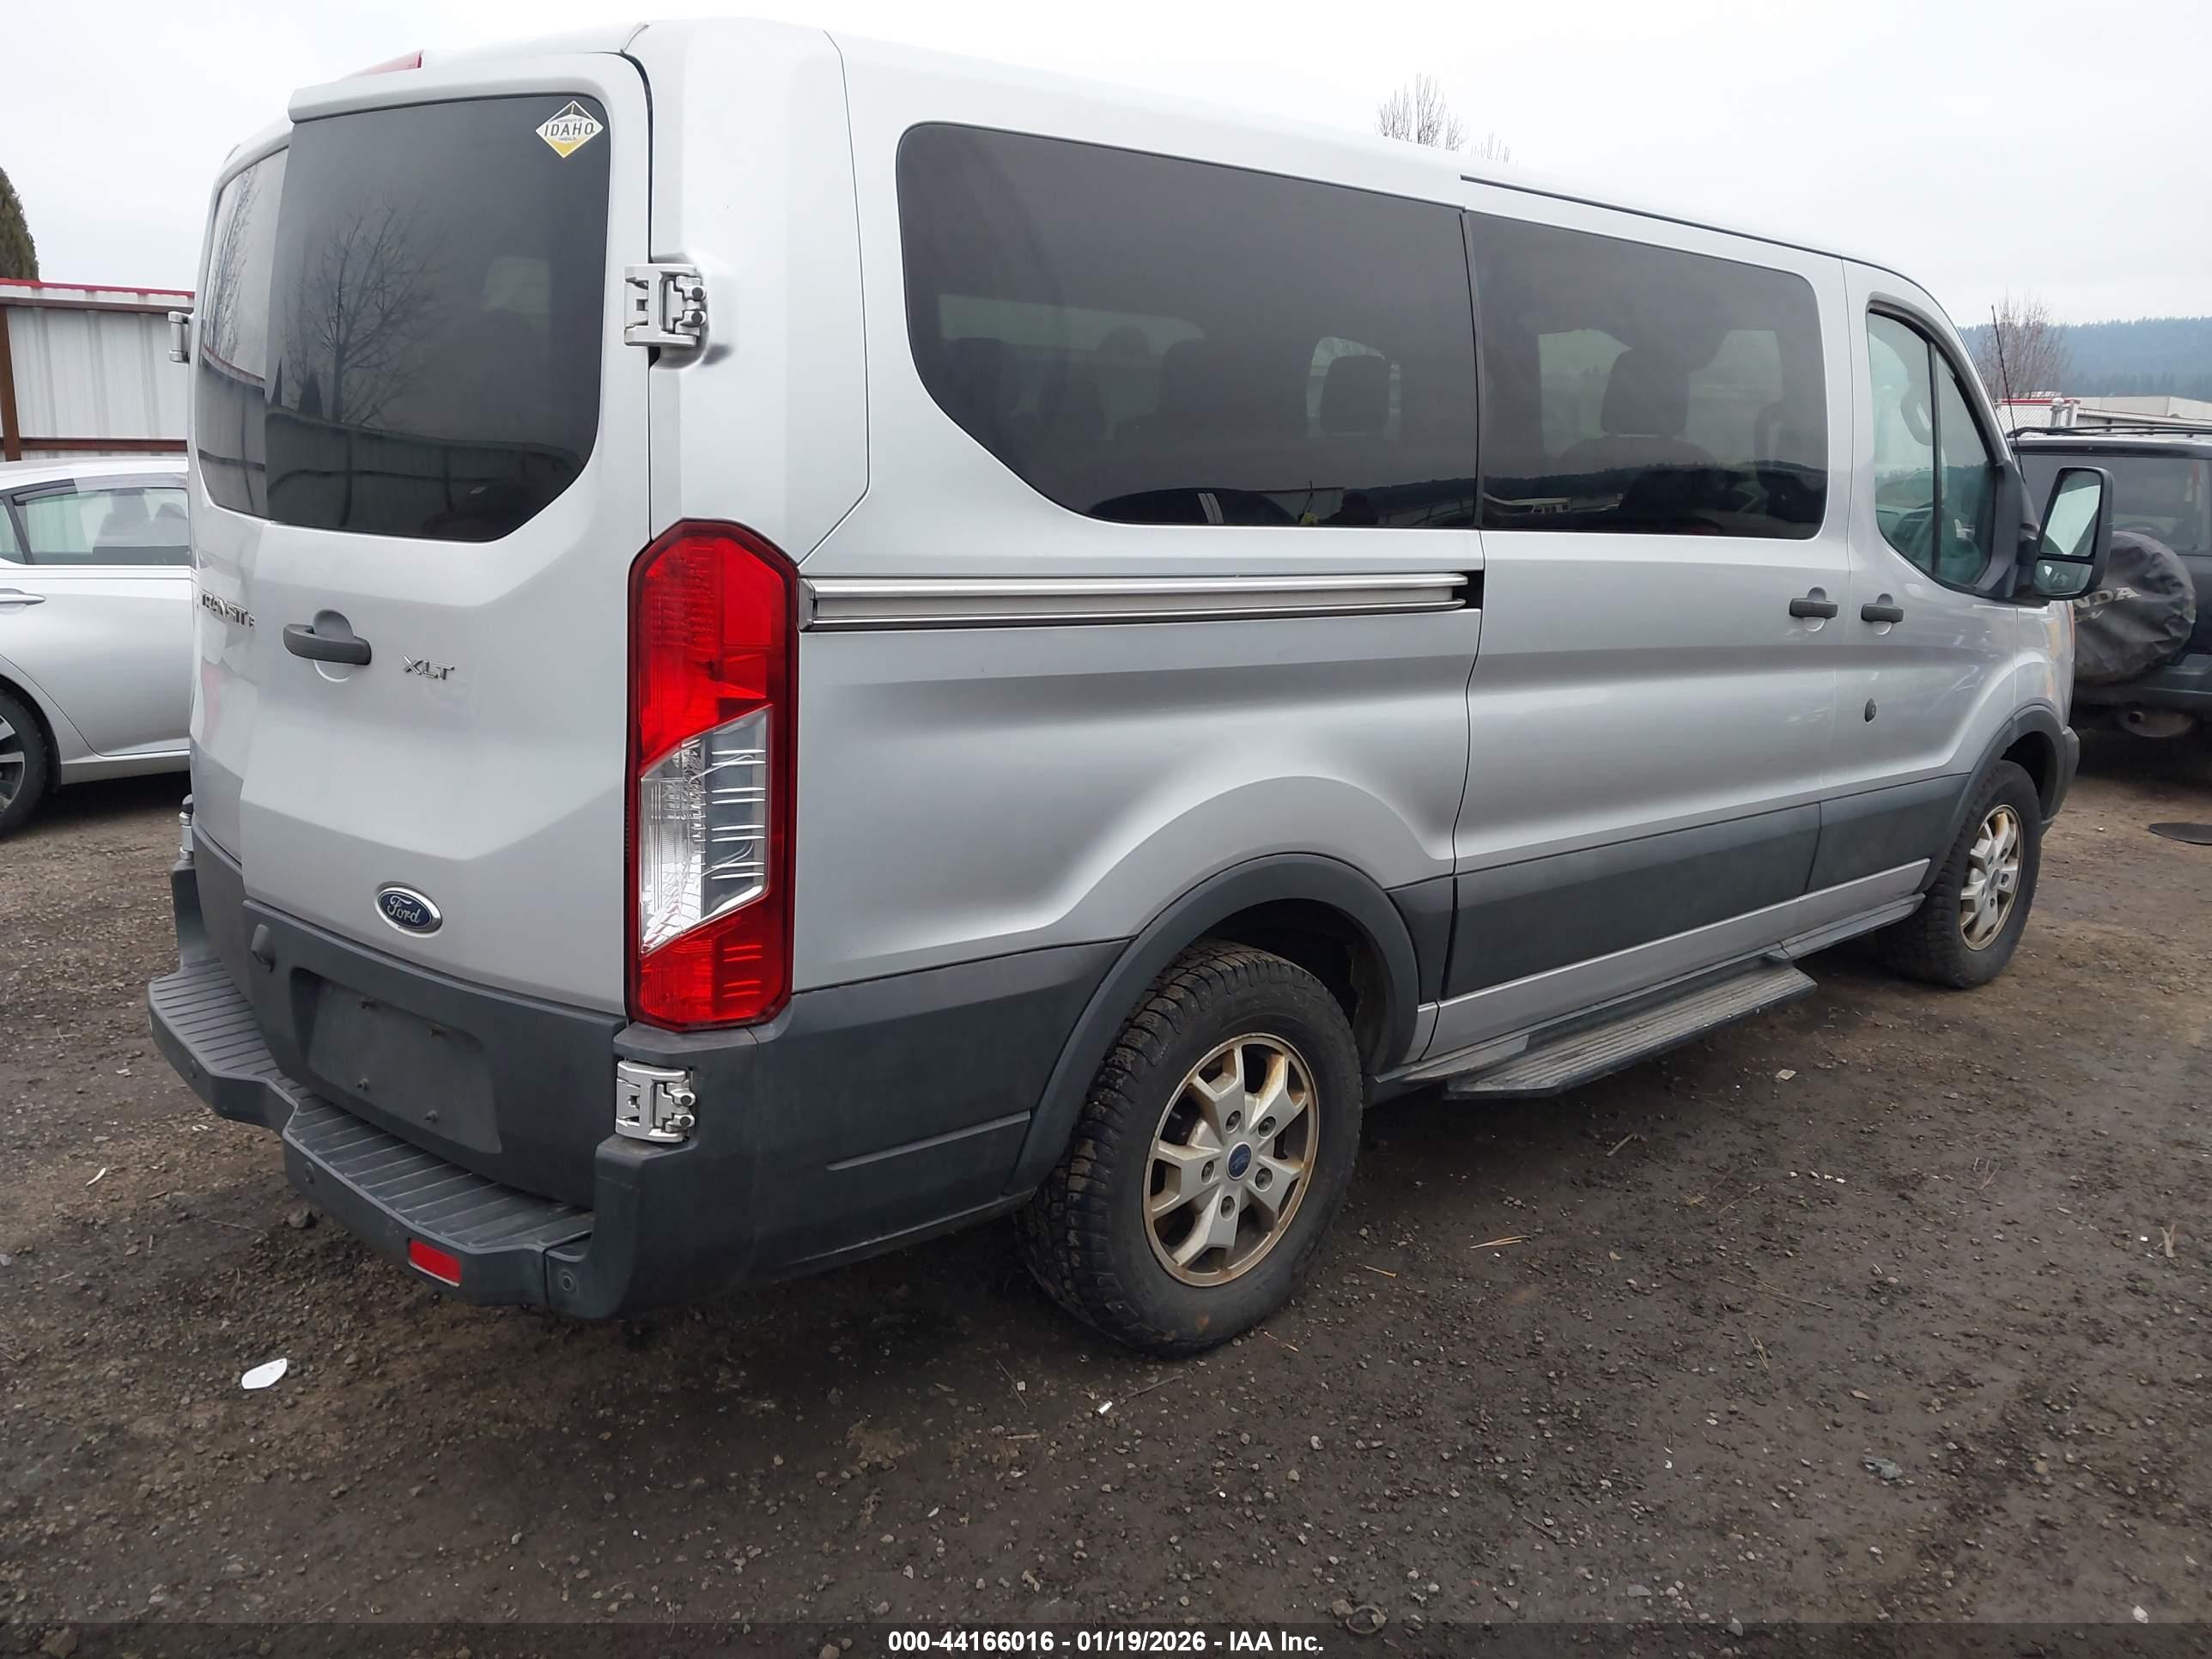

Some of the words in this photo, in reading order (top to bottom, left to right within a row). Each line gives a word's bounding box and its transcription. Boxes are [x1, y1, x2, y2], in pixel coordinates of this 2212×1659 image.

[544, 122, 594, 137] IDAHO
[198, 589, 248, 626] TRANSIT
[2073, 586, 2142, 609] NDA
[402, 655, 455, 680] XLT
[386, 895, 421, 924] Ford
